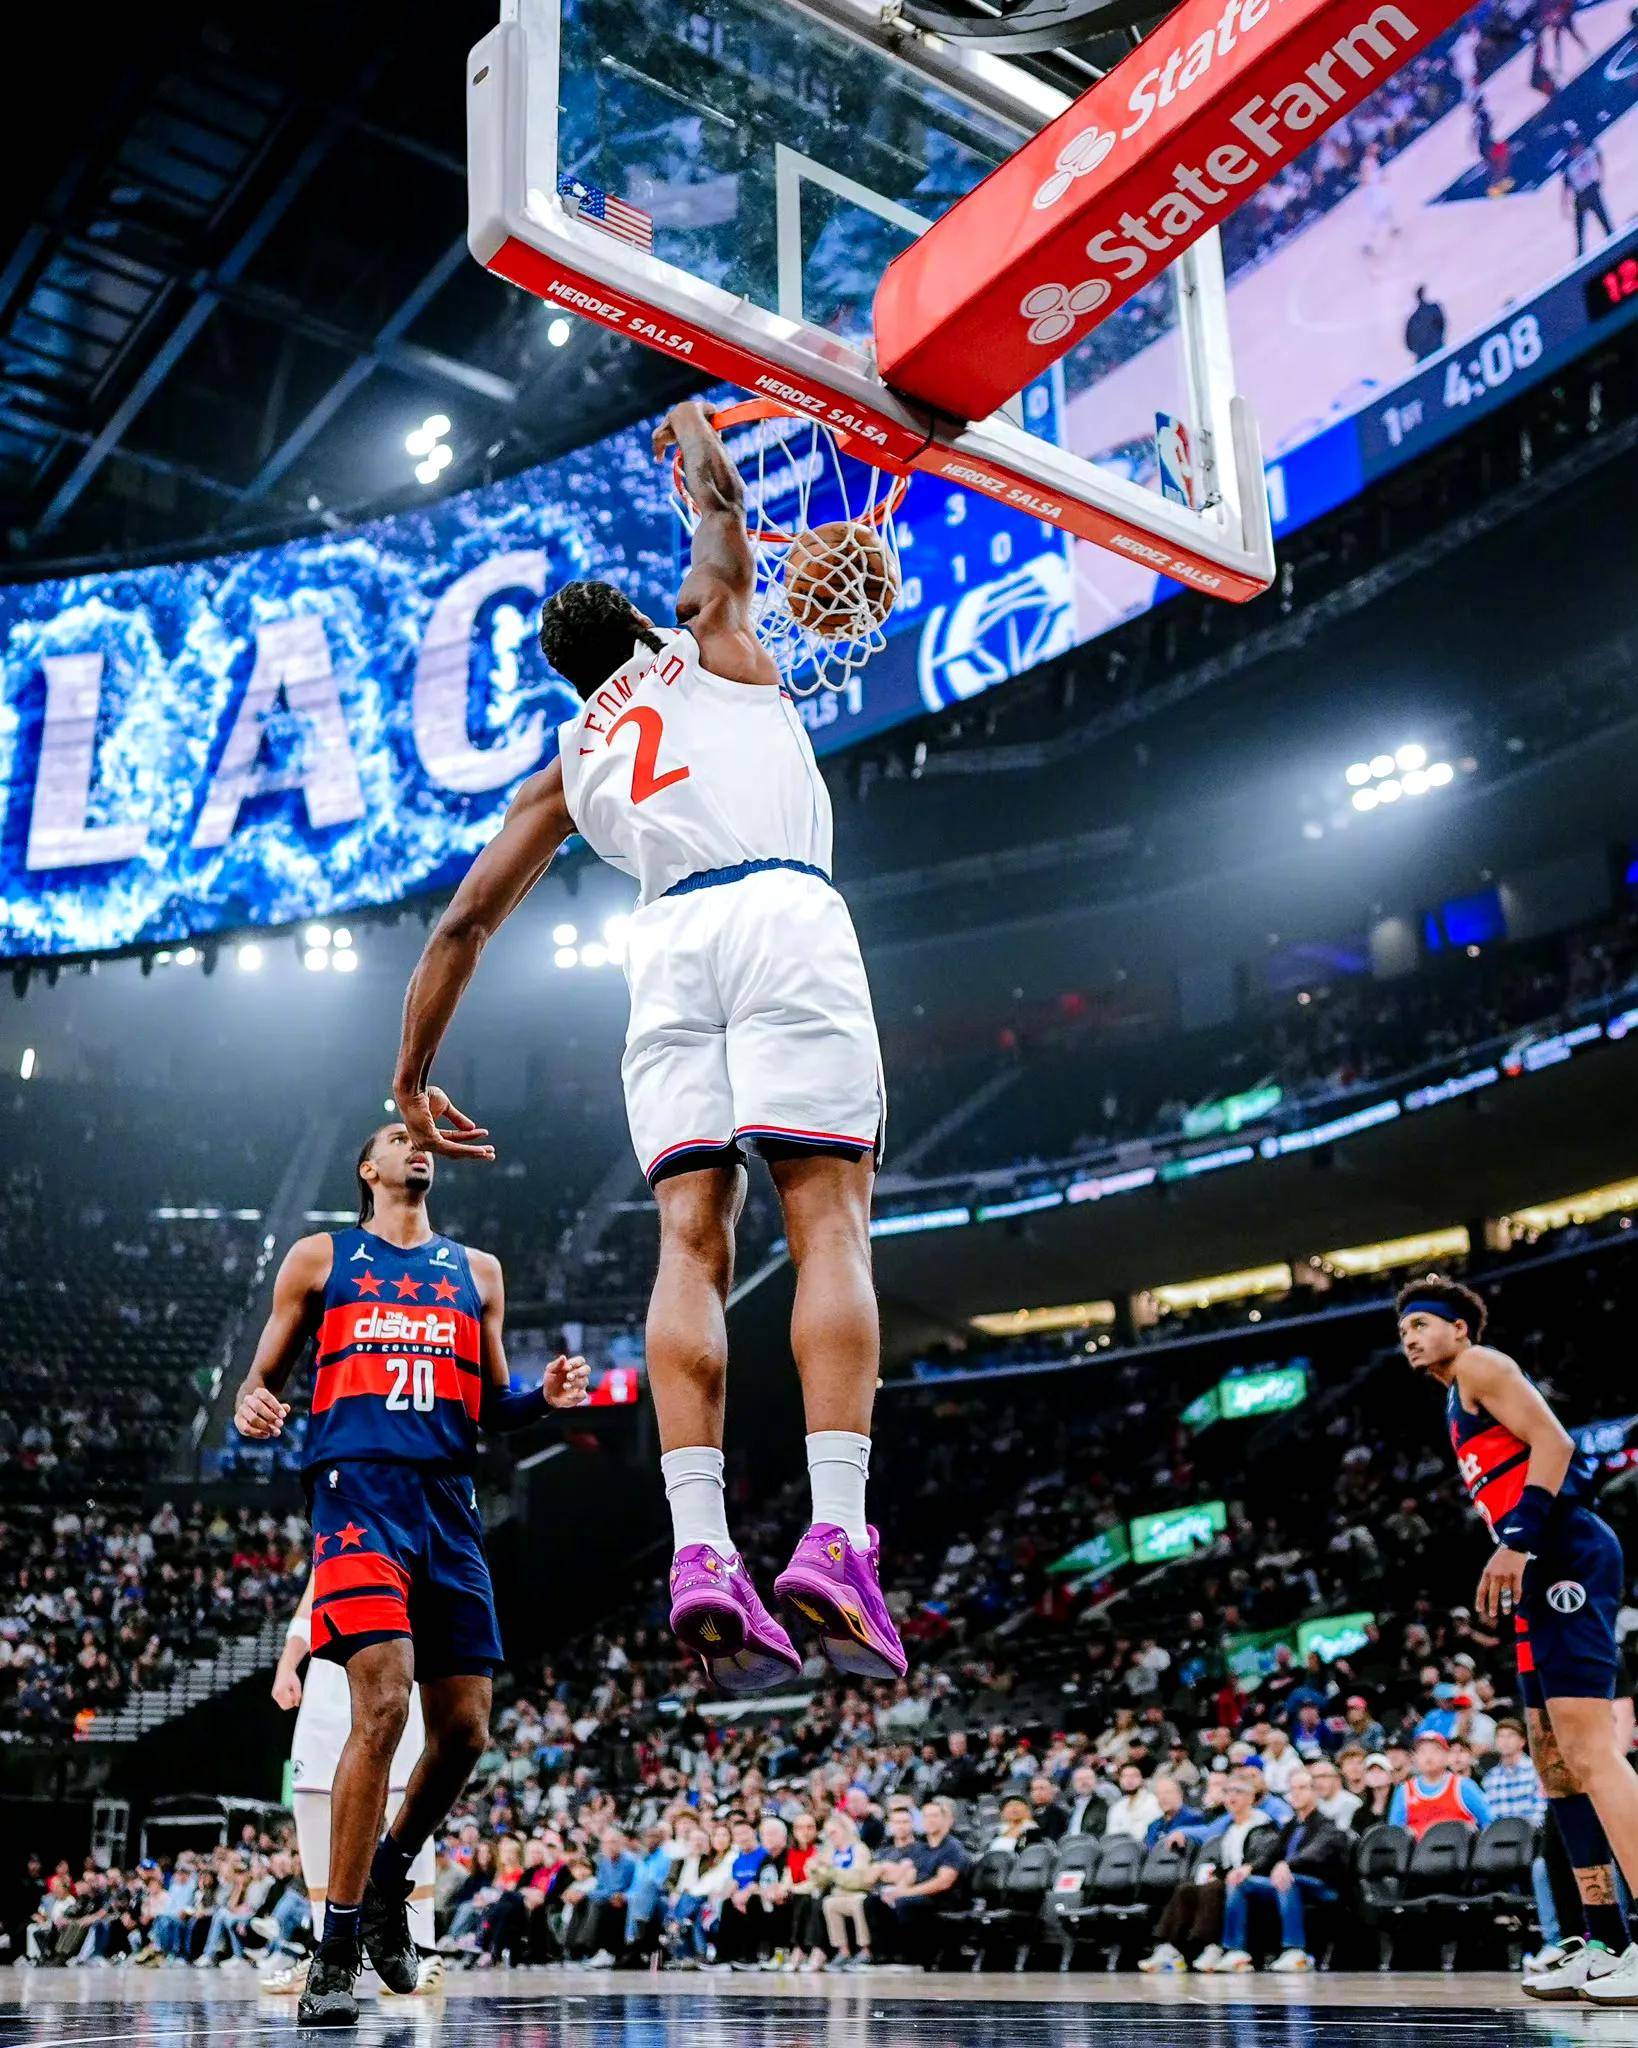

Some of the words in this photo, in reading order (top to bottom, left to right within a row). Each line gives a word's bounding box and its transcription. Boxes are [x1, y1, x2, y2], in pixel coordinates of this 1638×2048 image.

[547, 279, 627, 323] HERDEZ
[627, 317, 694, 355] SALSA
[1443, 313, 1544, 407] 4:08
[754, 374, 828, 413] HERDEZ
[827, 408, 888, 446] SALSA
[940, 463, 1007, 493] HERDEZ
[1006, 488, 1063, 519] SALSA
[1110, 533, 1171, 566] HERDEZ
[1169, 560, 1221, 589] SALSA
[26, 547, 550, 871] LAC
[578, 654, 684, 757] EOND
[605, 705, 690, 806] 2
[354, 1306, 456, 1345] district
[385, 1358, 435, 1412] 20
